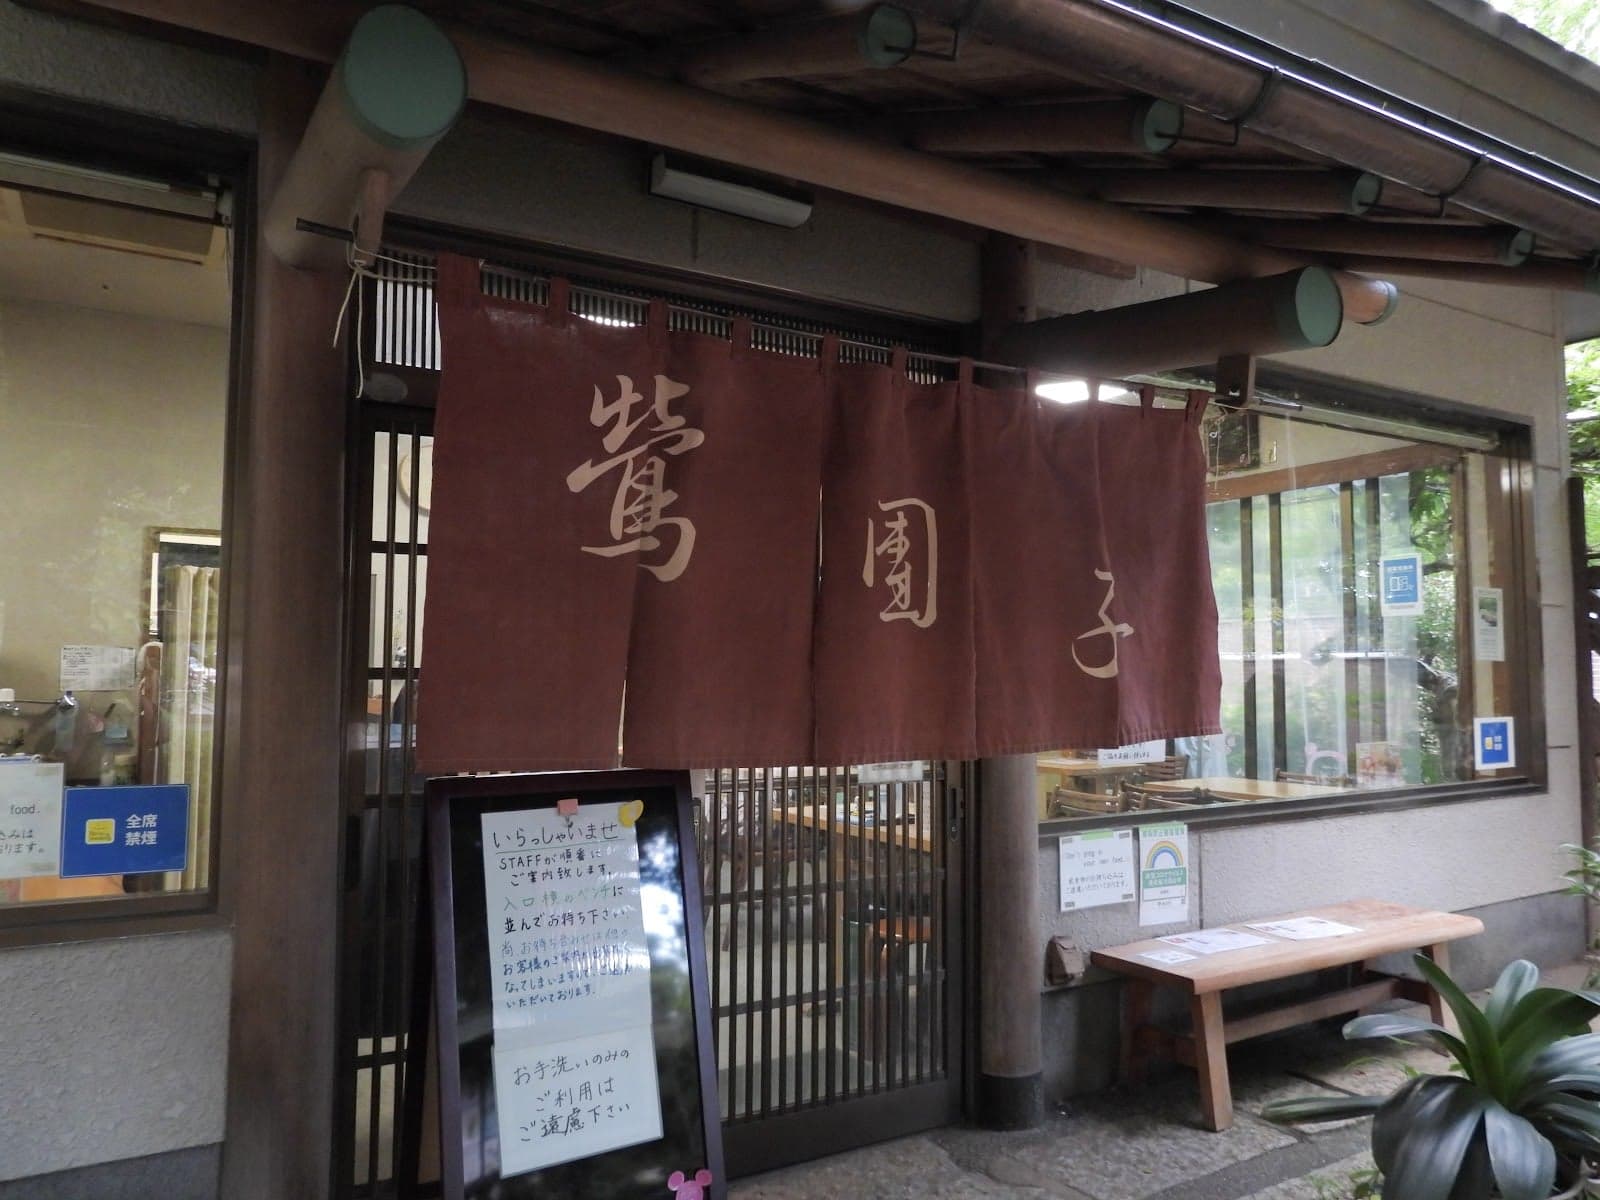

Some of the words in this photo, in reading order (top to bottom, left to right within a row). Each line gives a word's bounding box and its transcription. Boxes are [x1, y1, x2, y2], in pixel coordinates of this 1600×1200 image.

[125, 813, 158, 829] 全席
[493, 822, 619, 849] いらっしゃいませ
[125, 830, 158, 846] 禁煙
[513, 1049, 631, 1086] お手洗いのみの
[535, 1077, 615, 1112] ご利用は
[519, 1102, 630, 1143] ご遠慮下さい
